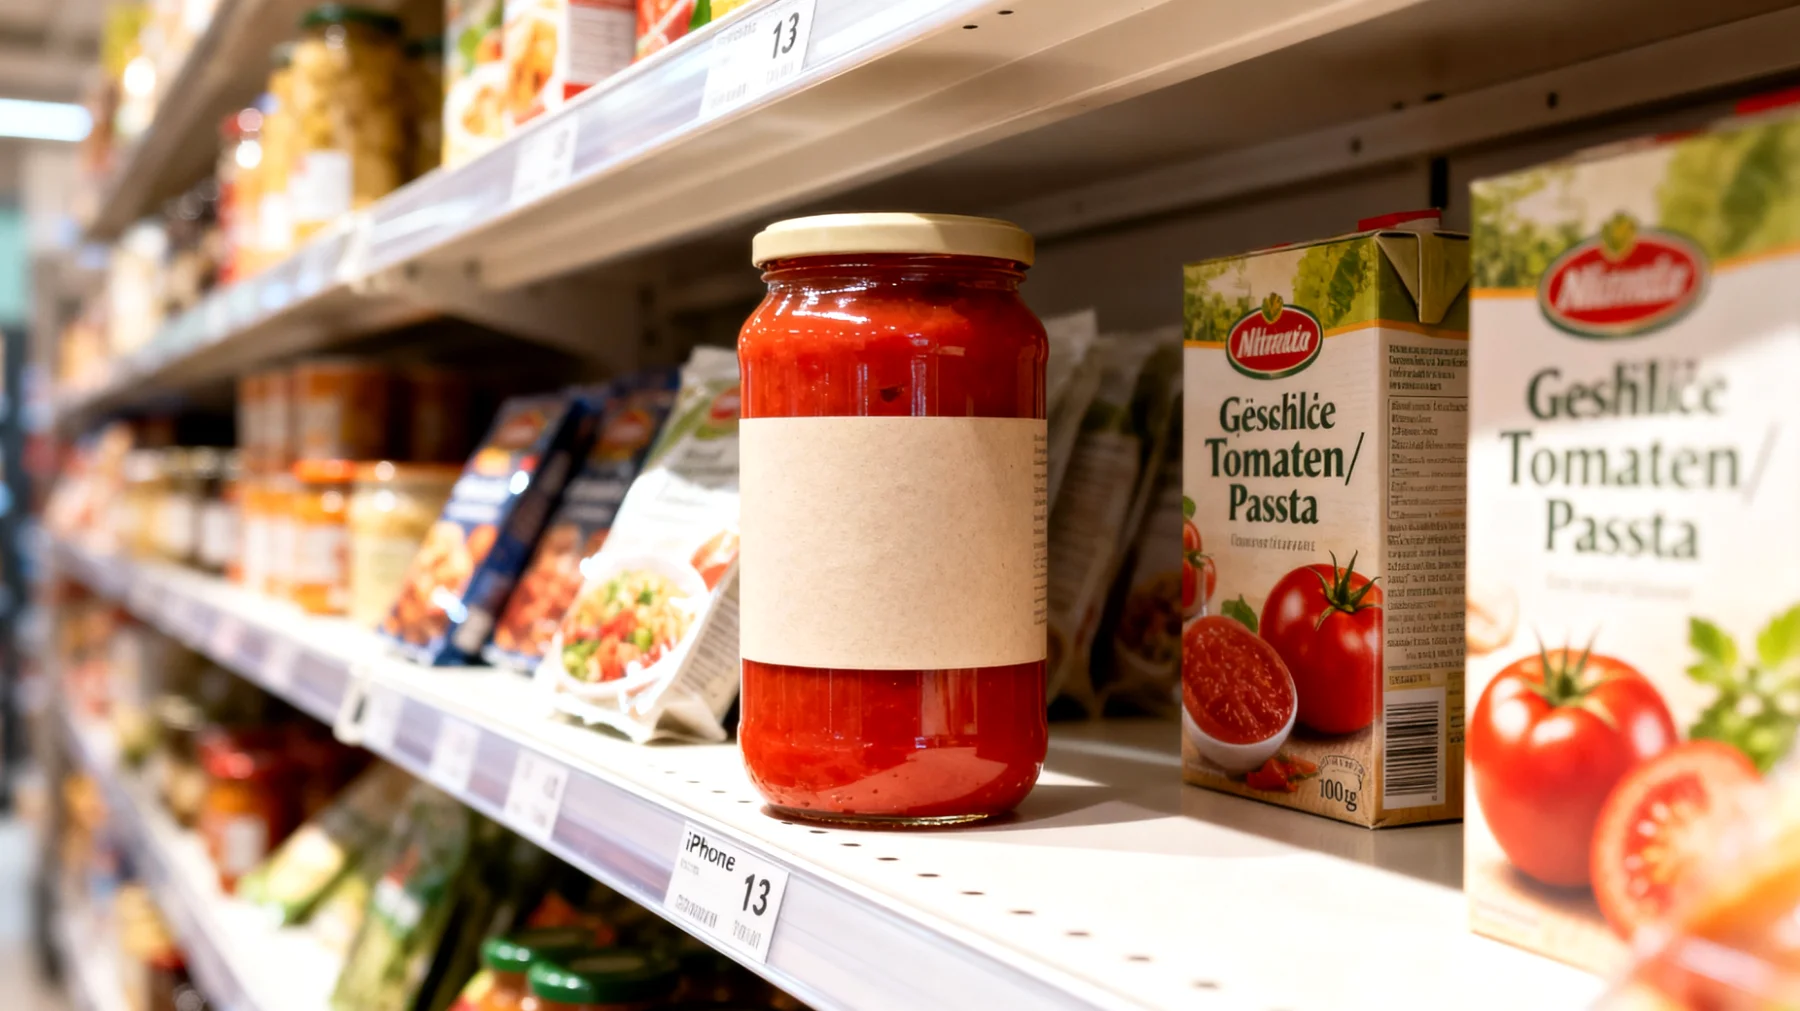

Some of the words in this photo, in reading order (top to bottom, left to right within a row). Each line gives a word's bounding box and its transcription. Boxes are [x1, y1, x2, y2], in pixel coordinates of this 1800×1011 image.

[772, 12, 800, 59] 13
[1204, 432, 1365, 486] Tomaten/
[1229, 484, 1319, 525] Passta
[1545, 499, 1699, 560] Passta
[685, 831, 736, 872] iPhone
[742, 873, 771, 917] 13
